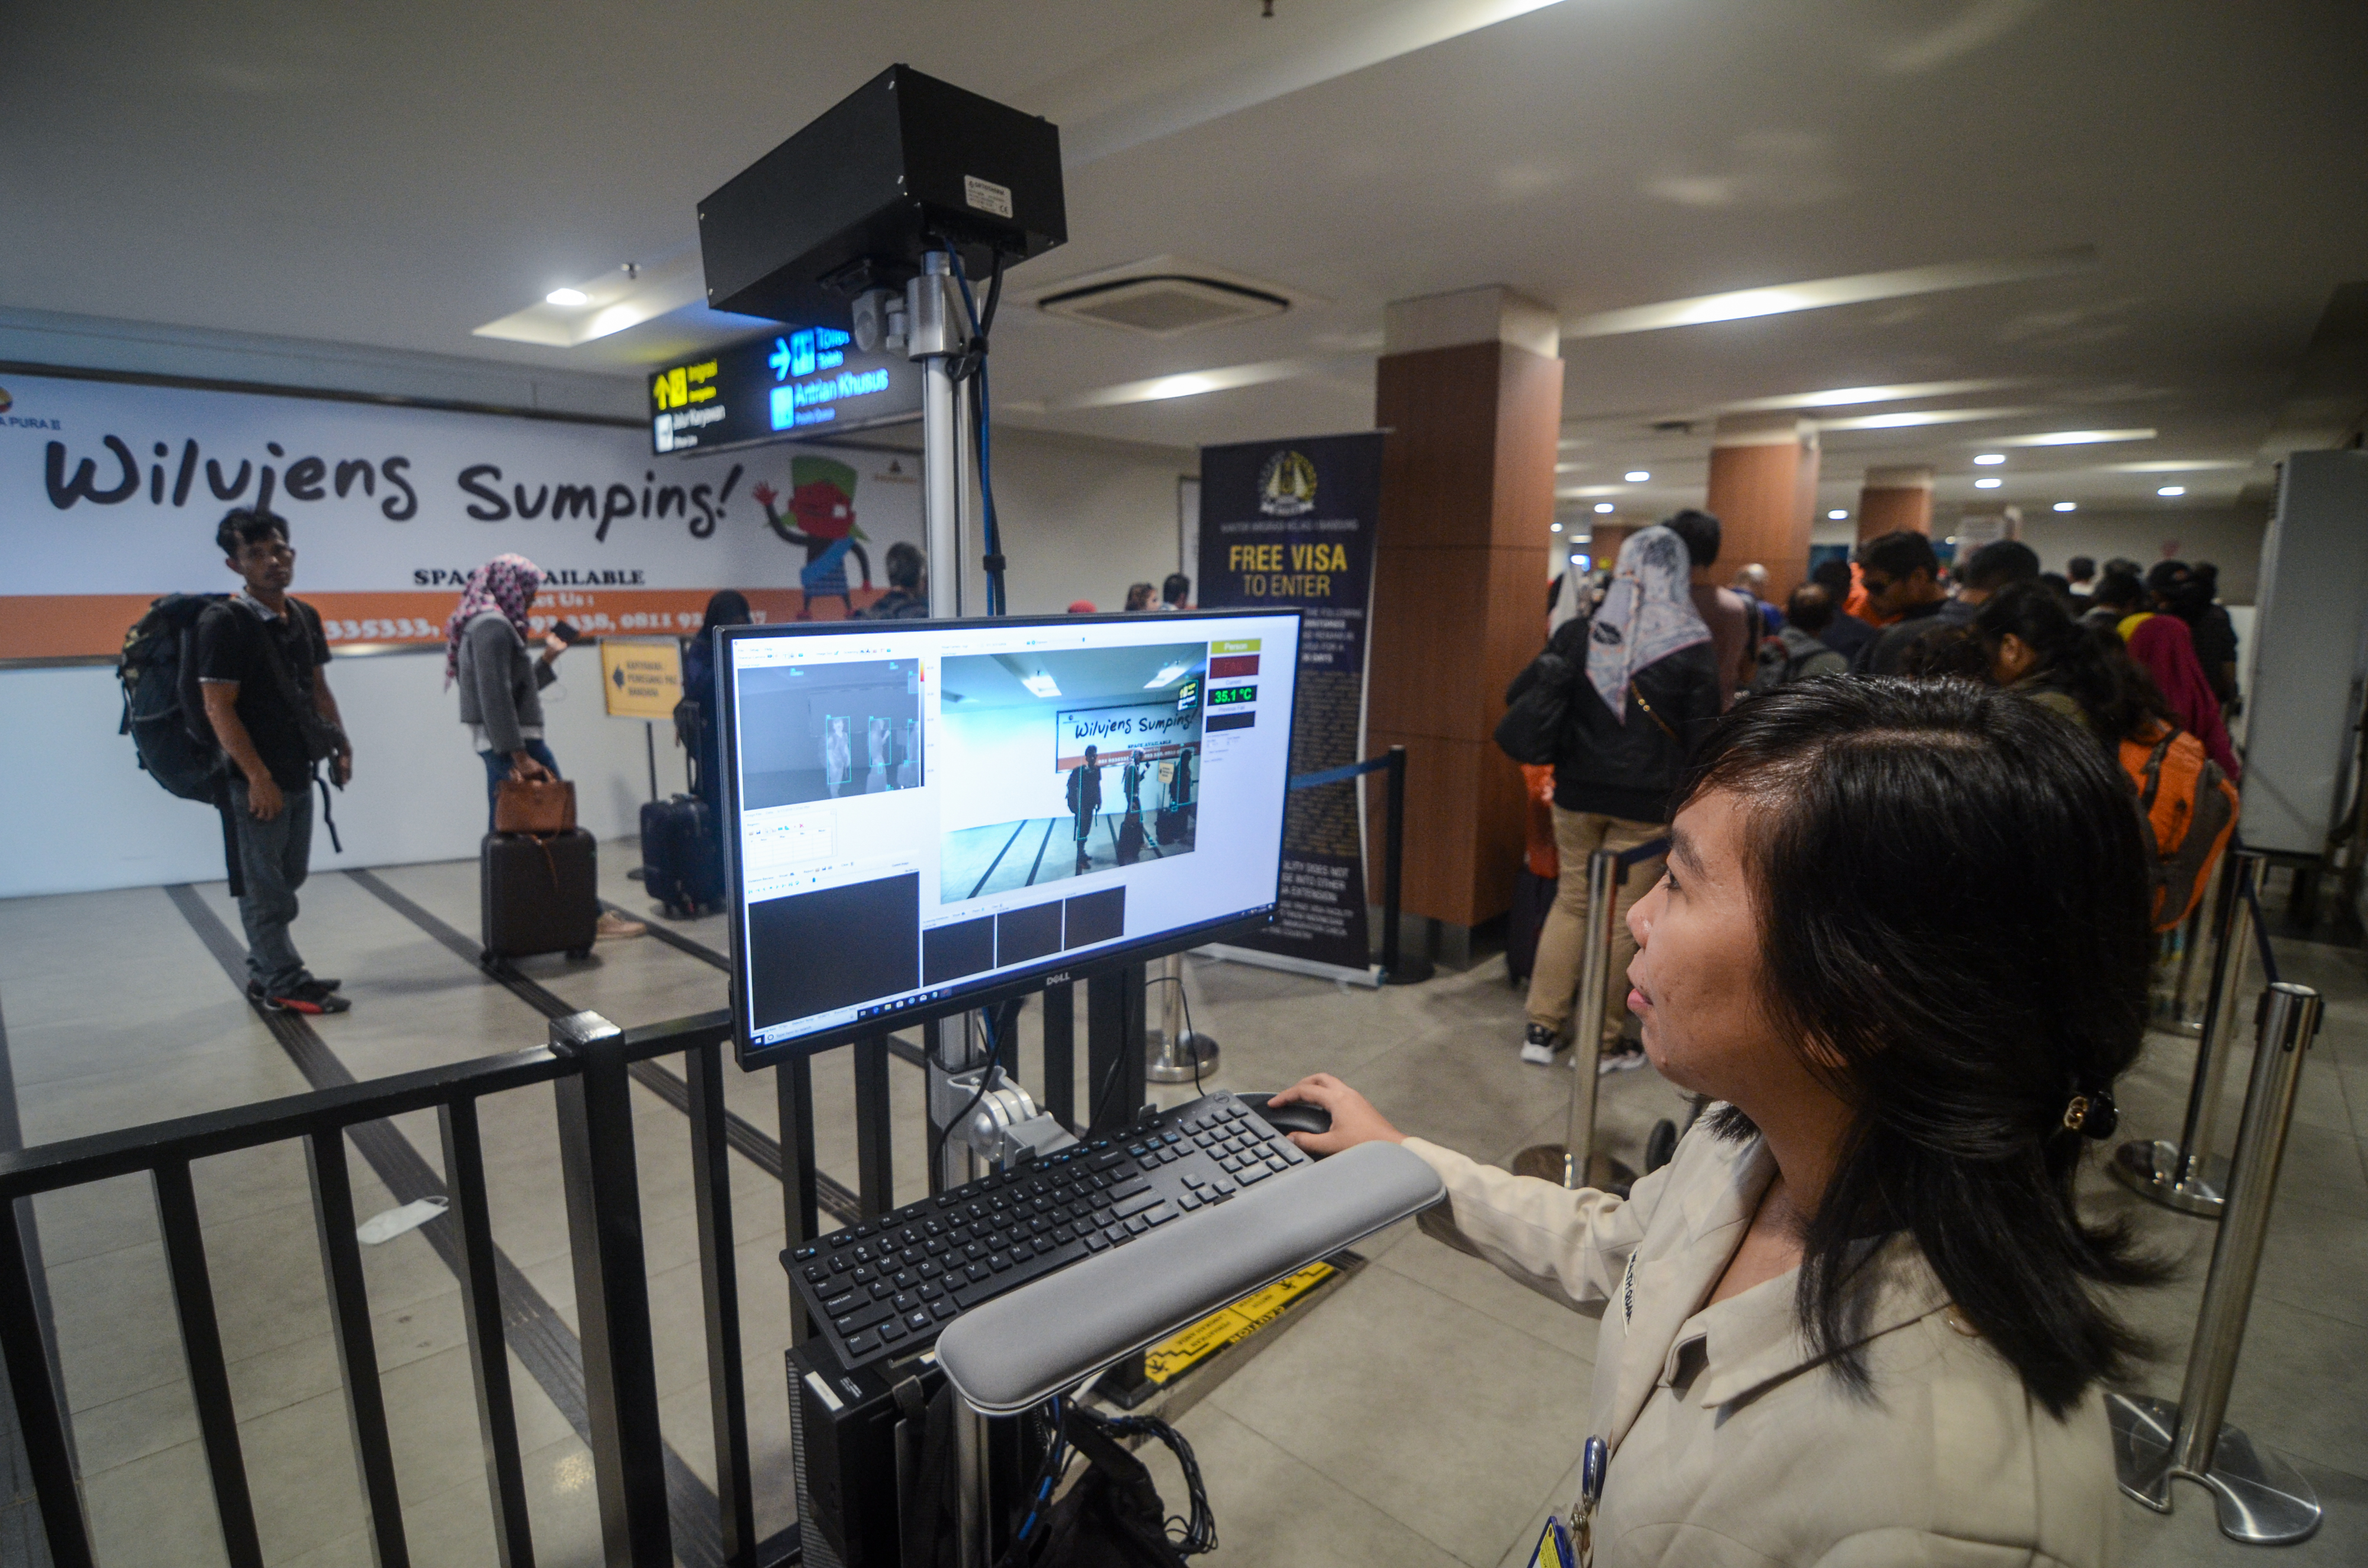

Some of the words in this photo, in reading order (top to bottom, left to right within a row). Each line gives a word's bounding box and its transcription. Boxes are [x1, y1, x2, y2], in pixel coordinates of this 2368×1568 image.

[794, 378, 836, 408] Antrian
[836, 368, 889, 399] Khusus
[8, 417, 49, 429] PURA
[1229, 544, 1283, 572] FREE
[1291, 543, 1348, 572] VISA
[1243, 574, 1266, 597] TO
[1270, 574, 1331, 597] ENTER
[620, 610, 673, 628] 0811
[1224, 642, 1248, 651] Person
[1215, 689, 1236, 703] 35.1
[1046, 971, 1070, 986] DELL
